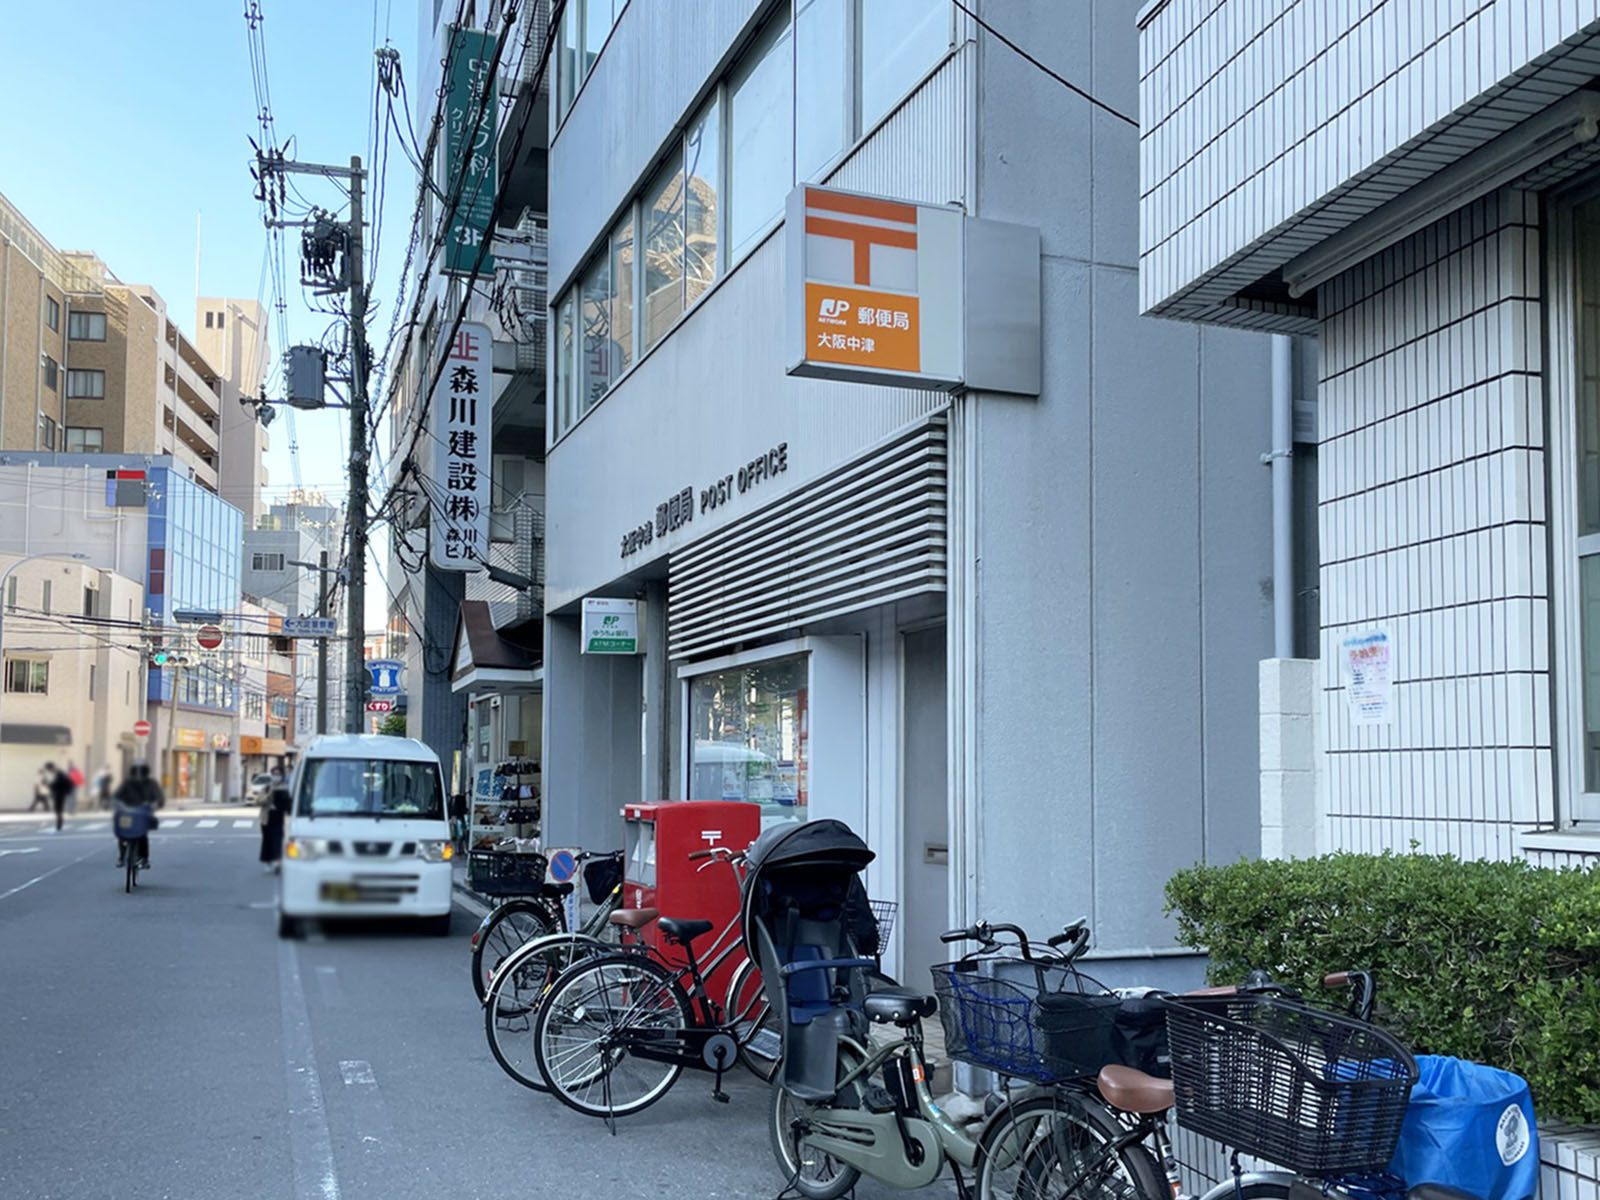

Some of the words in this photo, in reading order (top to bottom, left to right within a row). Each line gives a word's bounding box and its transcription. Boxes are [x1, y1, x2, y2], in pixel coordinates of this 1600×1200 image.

[454, 226, 484, 247] 3F
[819, 298, 850, 318] JP
[858, 306, 910, 331] 郵便局
[817, 332, 875, 353] 大阪中津
[656, 485, 693, 538] 郵便局
[700, 474, 733, 515] POST
[737, 442, 788, 494] OFFICE
[445, 544, 477, 560] ビル
